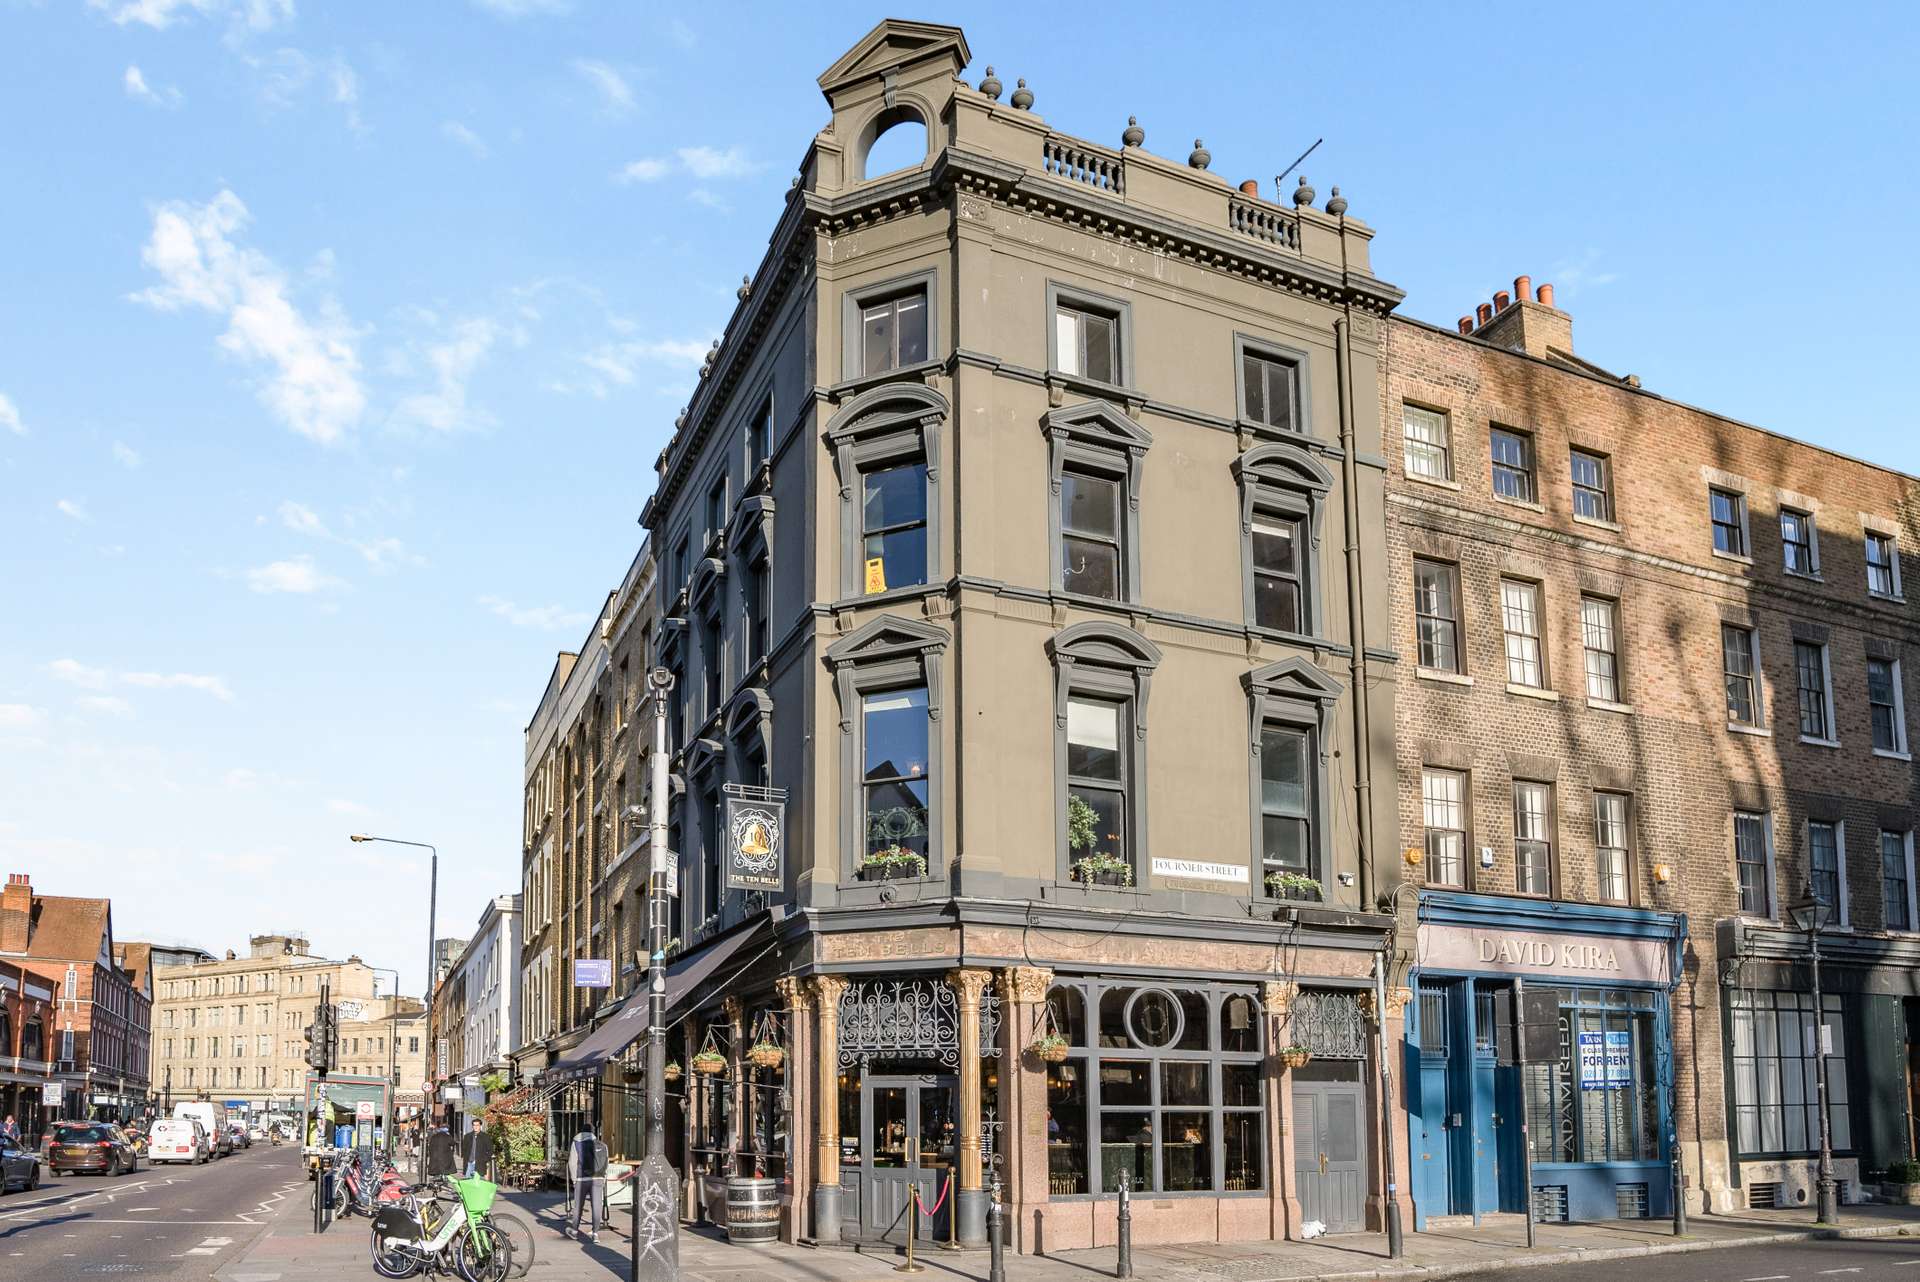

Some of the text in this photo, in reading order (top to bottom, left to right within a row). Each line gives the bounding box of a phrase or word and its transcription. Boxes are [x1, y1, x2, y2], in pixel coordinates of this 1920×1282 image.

[1155, 860, 1238, 877] FOURNIER STREET
[730, 874, 779, 885] THE TEN BELLS
[832, 942, 946, 959] TEN BELLS
[1479, 937, 1622, 971] DAVID KIRA
[1583, 1055, 1604, 1066] FOR
[1558, 1016, 1575, 1153] ADAM REED
